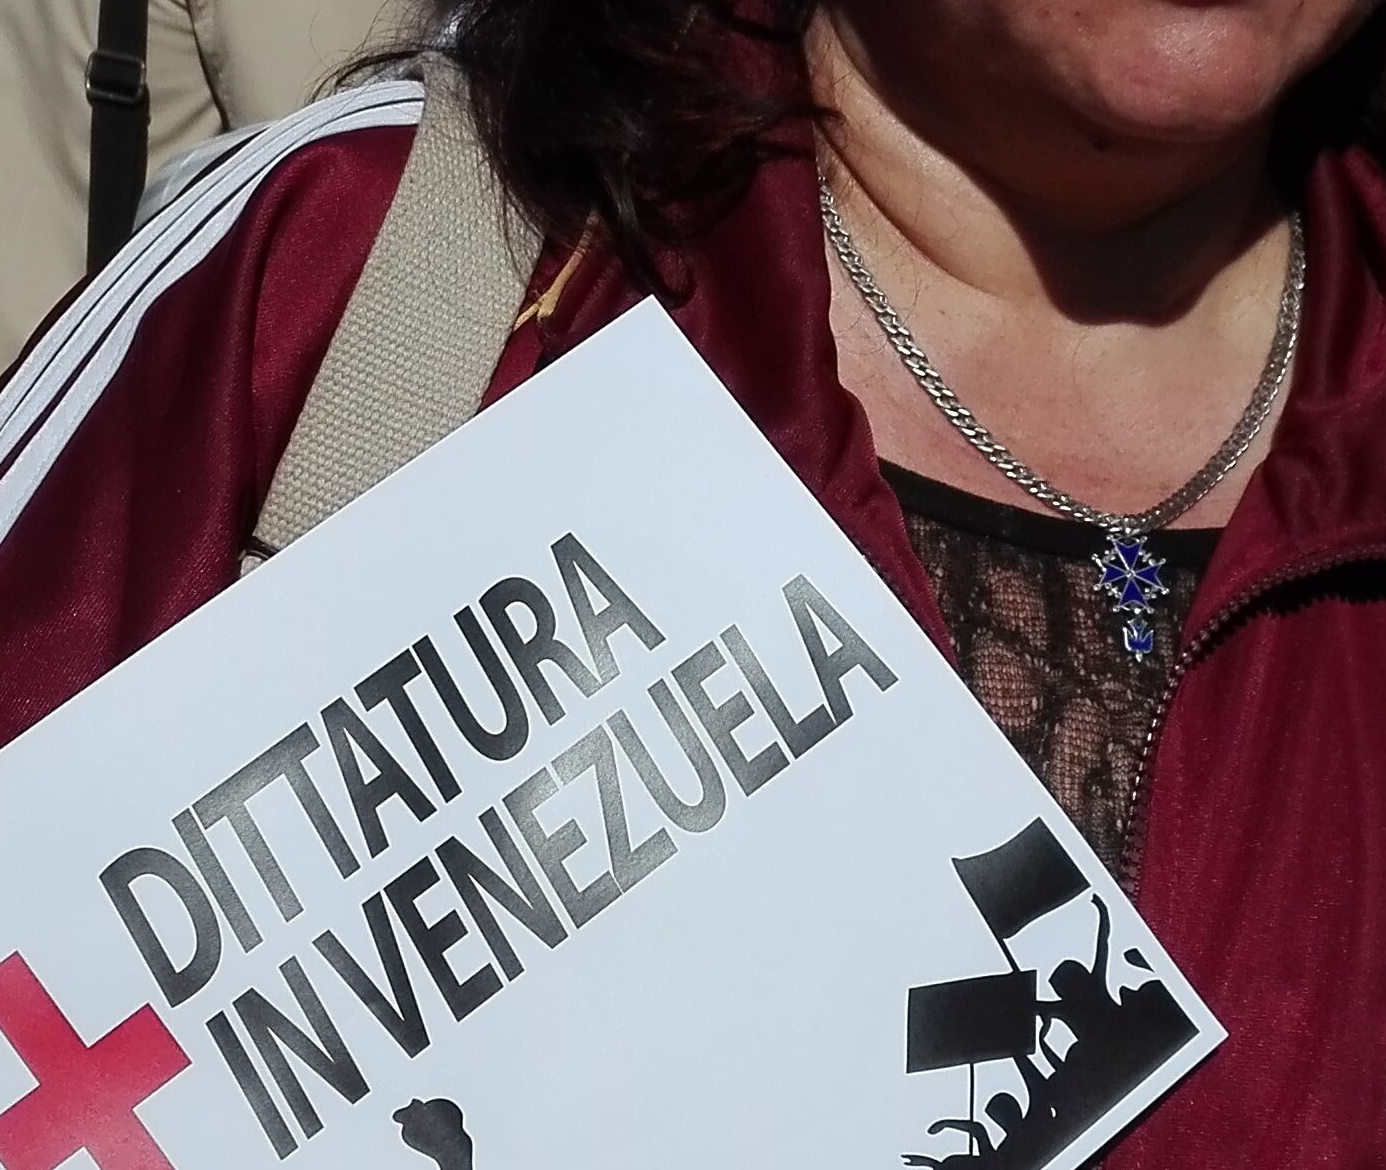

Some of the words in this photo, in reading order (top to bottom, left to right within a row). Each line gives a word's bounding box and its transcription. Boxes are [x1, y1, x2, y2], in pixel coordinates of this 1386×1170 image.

[99, 532, 666, 1008] DITTATURA
[206, 956, 370, 1161] IN
[312, 573, 899, 1059] VENEZUELA
